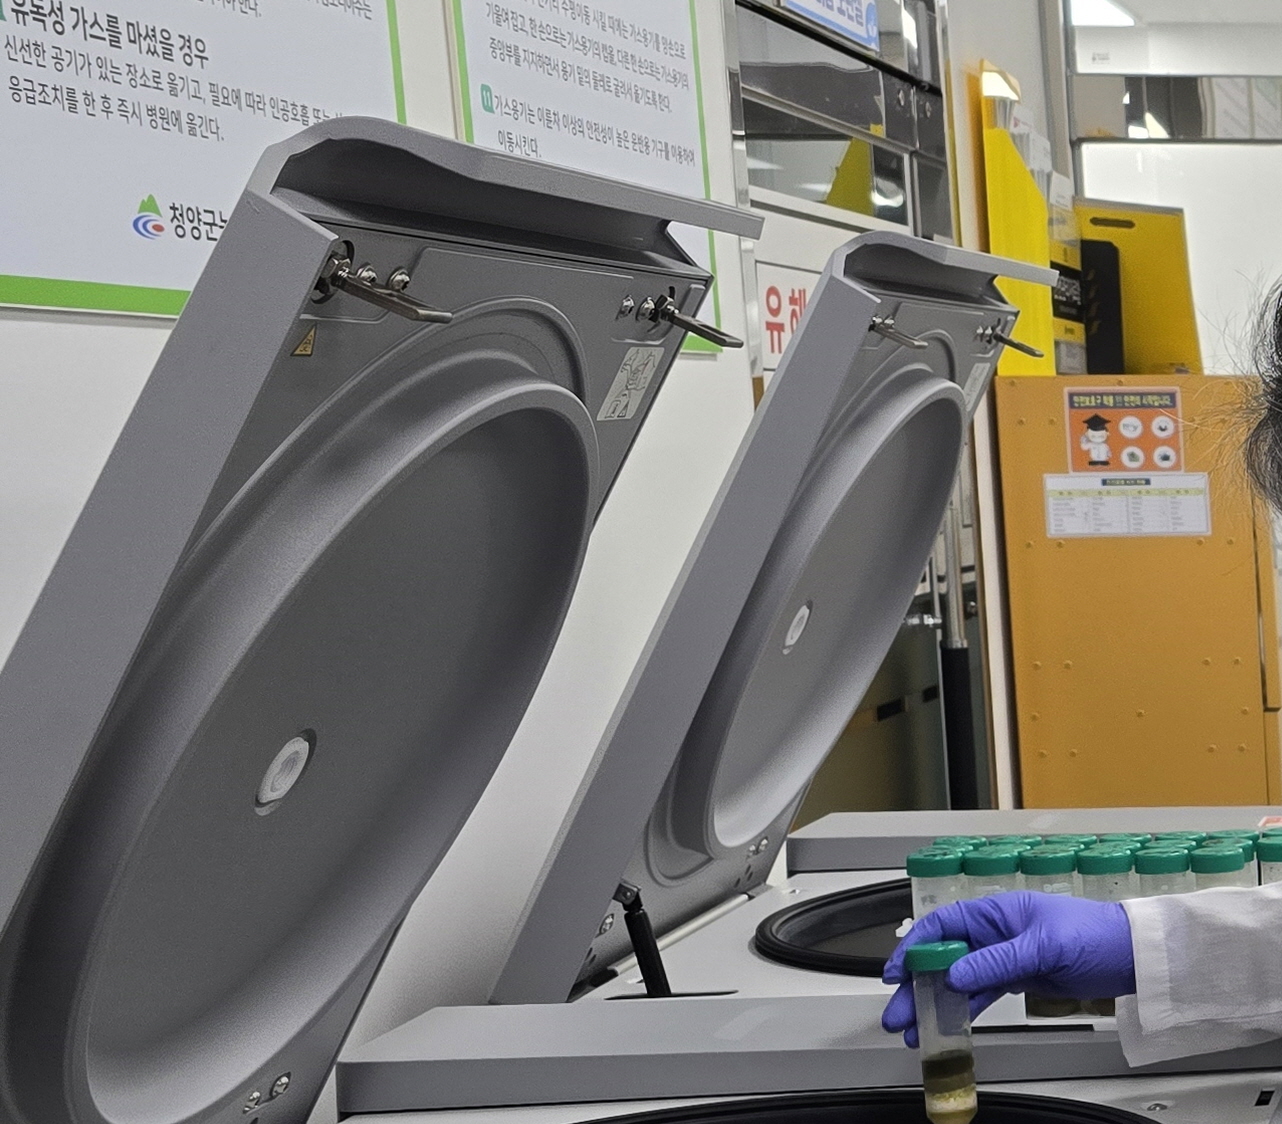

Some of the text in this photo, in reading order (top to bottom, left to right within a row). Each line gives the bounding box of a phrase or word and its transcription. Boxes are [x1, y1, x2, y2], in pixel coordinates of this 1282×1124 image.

[486, 2, 510, 30] 기울여
[11, 0, 209, 69] 유독성 가스를 마셨을 경우
[489, 36, 521, 67] 중앙부를
[4, 34, 47, 68] 신선한
[51, 45, 92, 79] 공기가
[96, 56, 122, 85] 있는
[125, 63, 164, 91] 장소로
[166, 72, 206, 104] 옮기고,
[208, 82, 243, 112] 필요에
[244, 91, 267, 117] 따라
[269, 97, 310, 127] 인공호흡
[9, 75, 225, 142] 응급조치를 한 후 즉시 병원에 옮긴다.
[494, 95, 535, 125] 가스용기는
[498, 130, 542, 158] 이동시킨다.
